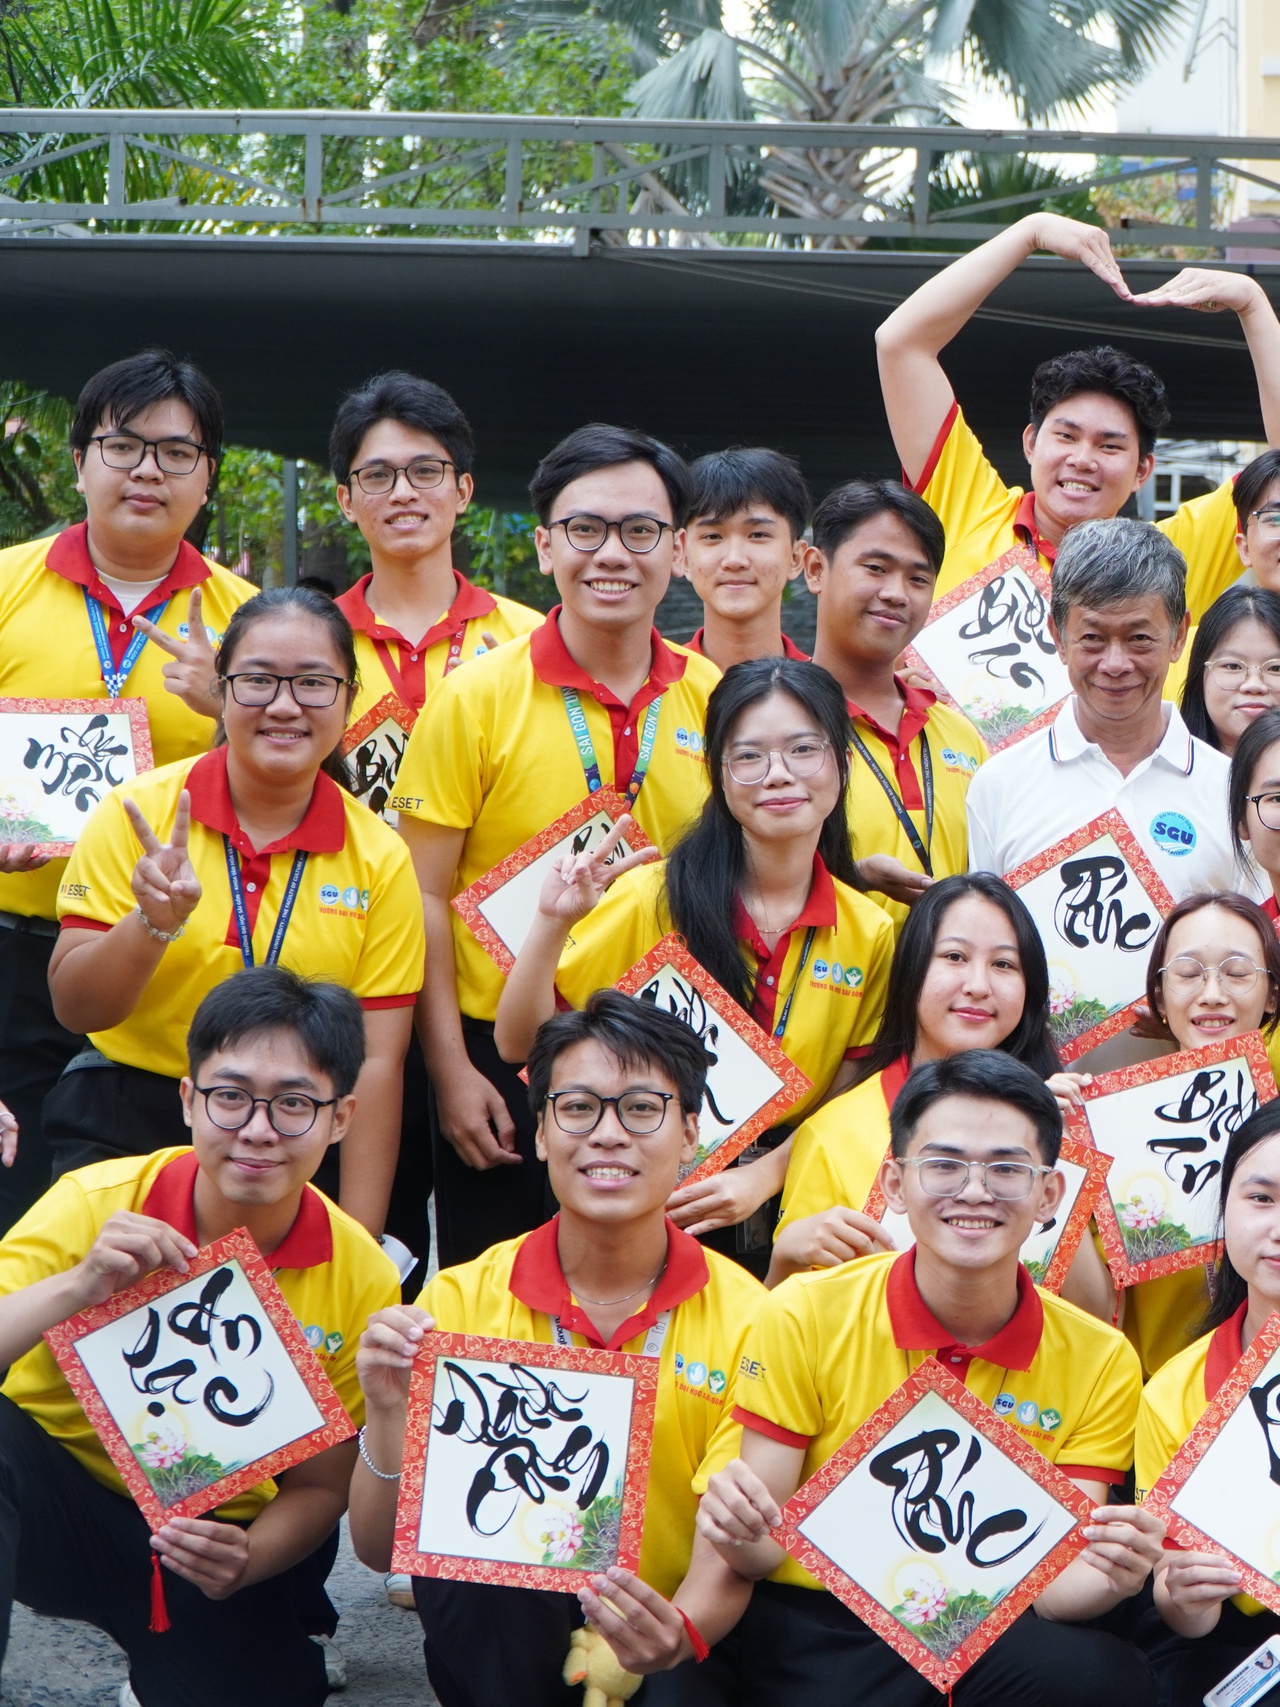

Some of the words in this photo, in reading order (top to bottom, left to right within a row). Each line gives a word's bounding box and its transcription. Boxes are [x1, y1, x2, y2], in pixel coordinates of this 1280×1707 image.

[569, 706, 586, 731] GON
[645, 714, 657, 739] GON
[577, 736, 593, 755] SAI
[639, 740, 652, 761] SAI
[1154, 822, 1193, 845] SGU
[321, 890, 338, 898] SGU
[273, 922, 285, 950] UNIVERSITY
[284, 888, 295, 908] FACULTY
[292, 861, 302, 882] CULTURE
[814, 964, 828, 973] SGU
[996, 1398, 1014, 1409] SGU
